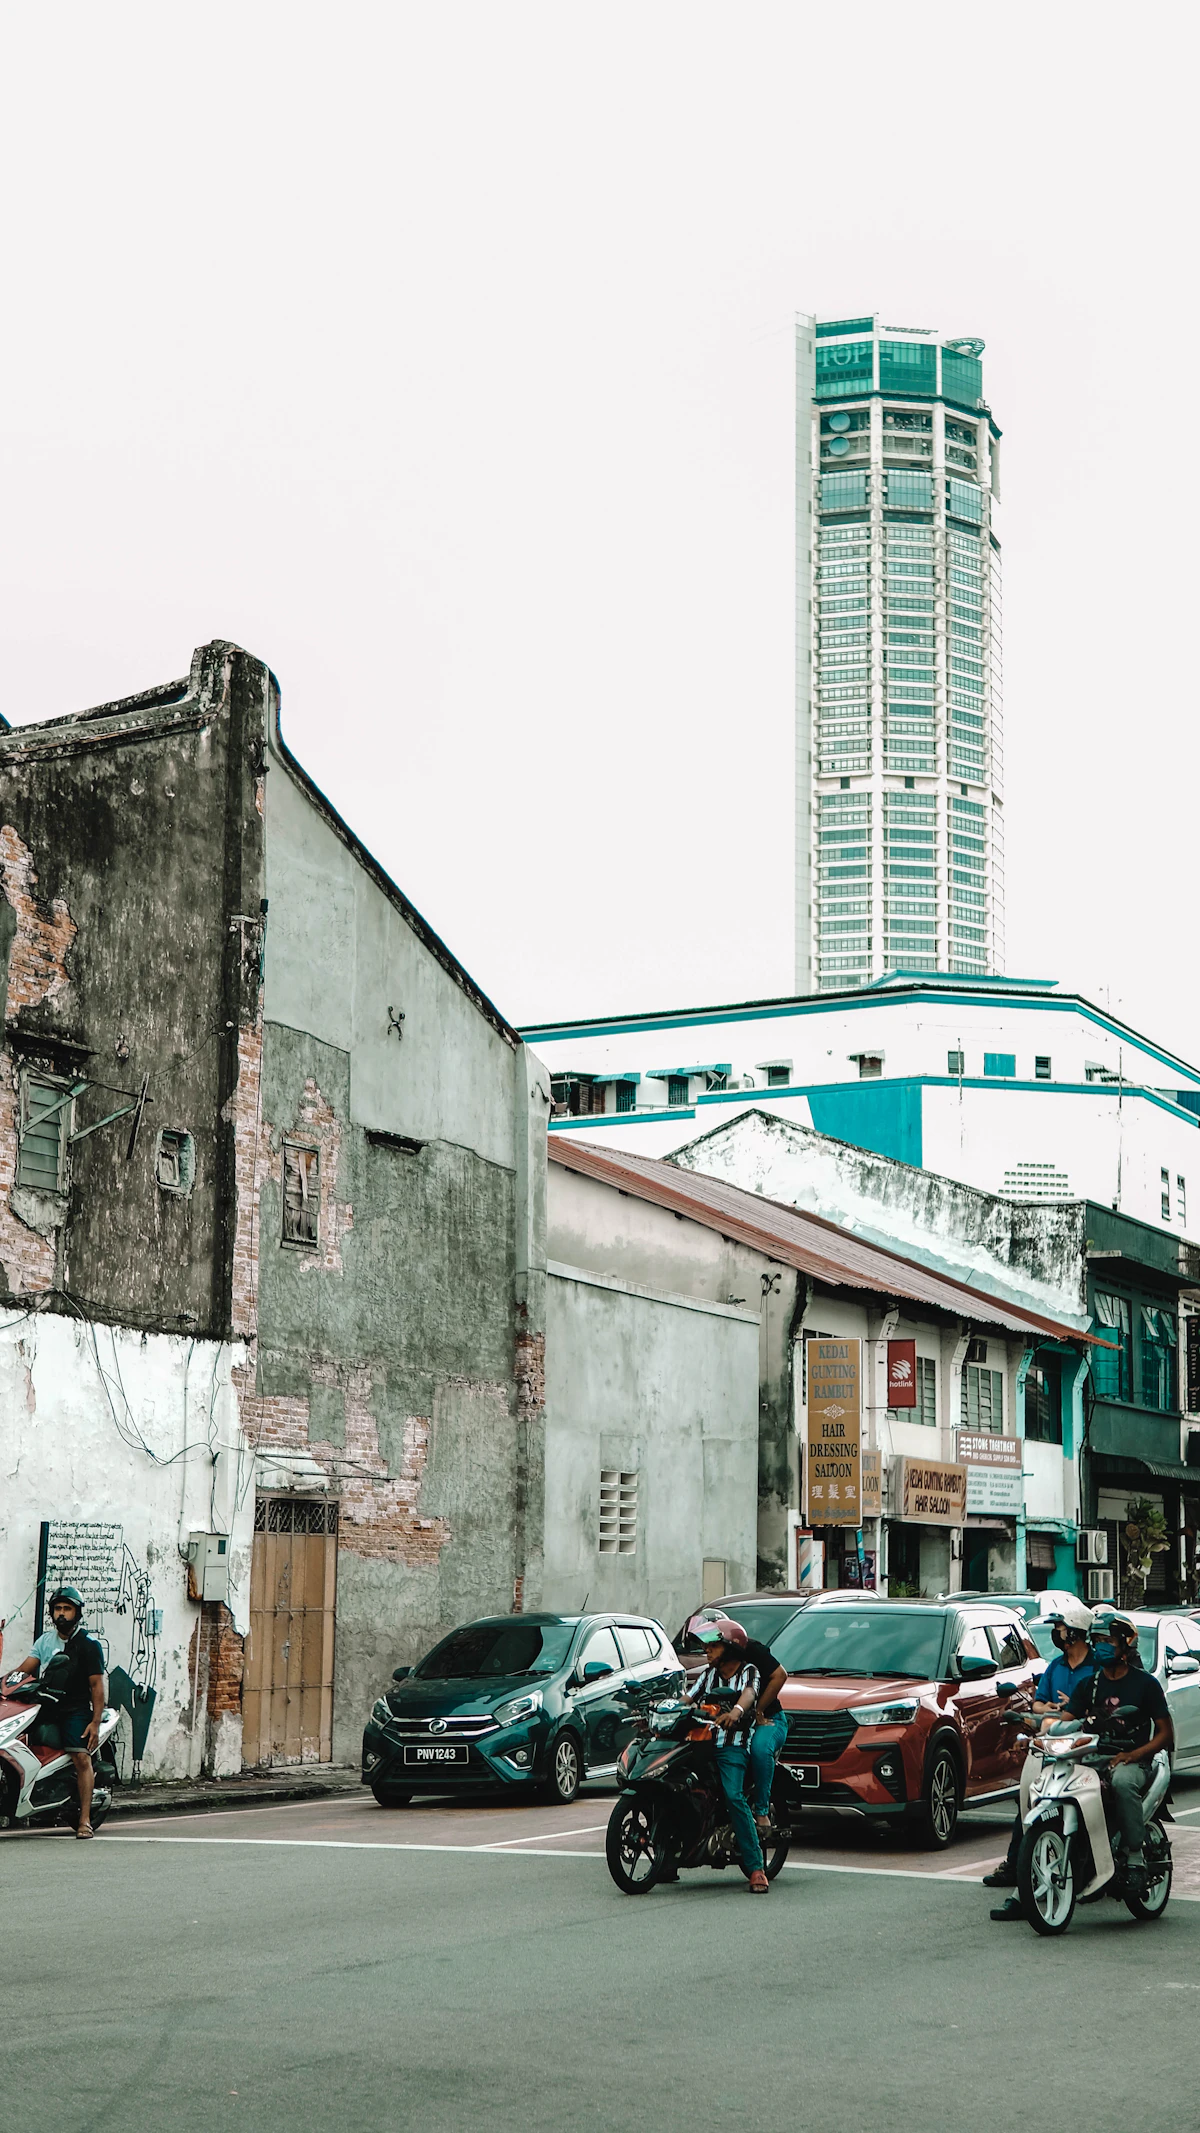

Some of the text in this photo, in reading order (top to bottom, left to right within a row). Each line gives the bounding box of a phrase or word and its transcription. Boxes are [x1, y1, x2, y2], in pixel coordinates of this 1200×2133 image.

[818, 344, 867, 367] TOP
[818, 1345, 849, 1359] KEDAI
[811, 1365, 856, 1379] GUNTING
[814, 1384, 854, 1399] RAMBUT
[890, 1380, 913, 1388] hotlink
[822, 1423, 846, 1438] HAIR
[810, 1443, 858, 1458] DRESSING
[972, 1437, 1016, 1454] STONE TREATMENT
[815, 1463, 852, 1478] SALOON
[910, 1468, 962, 1494] KEDAI GUNTING RAMBUT
[811, 1483, 857, 1500] 理髮室
[915, 1494, 951, 1515] HAIR SALOON
[417, 1748, 456, 1760] PNV1243
